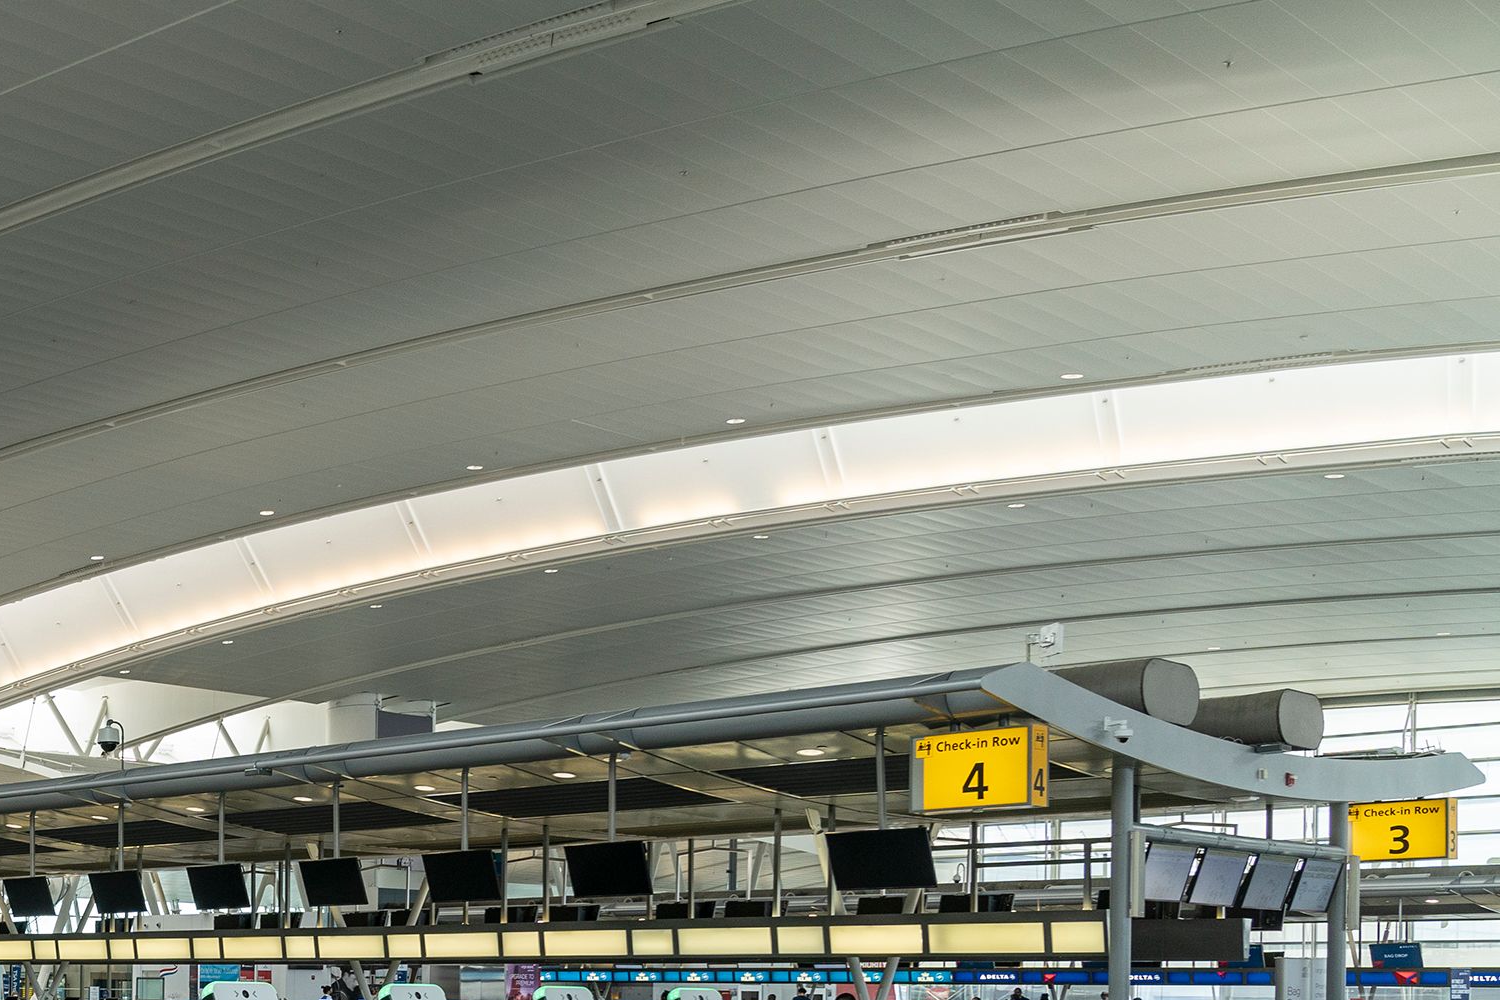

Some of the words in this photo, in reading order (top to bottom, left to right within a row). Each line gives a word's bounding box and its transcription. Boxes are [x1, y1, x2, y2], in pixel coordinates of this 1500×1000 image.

[936, 738, 988, 753] Check-in
[992, 736, 1021, 747] Row
[962, 762, 989, 800] 4
[1033, 768, 1045, 797] 4
[1363, 807, 1411, 818] Check-in
[1414, 806, 1440, 815] Row
[1388, 825, 1410, 855] 3
[1449, 830, 1456, 852] 3
[1287, 986, 1300, 997] Bag
